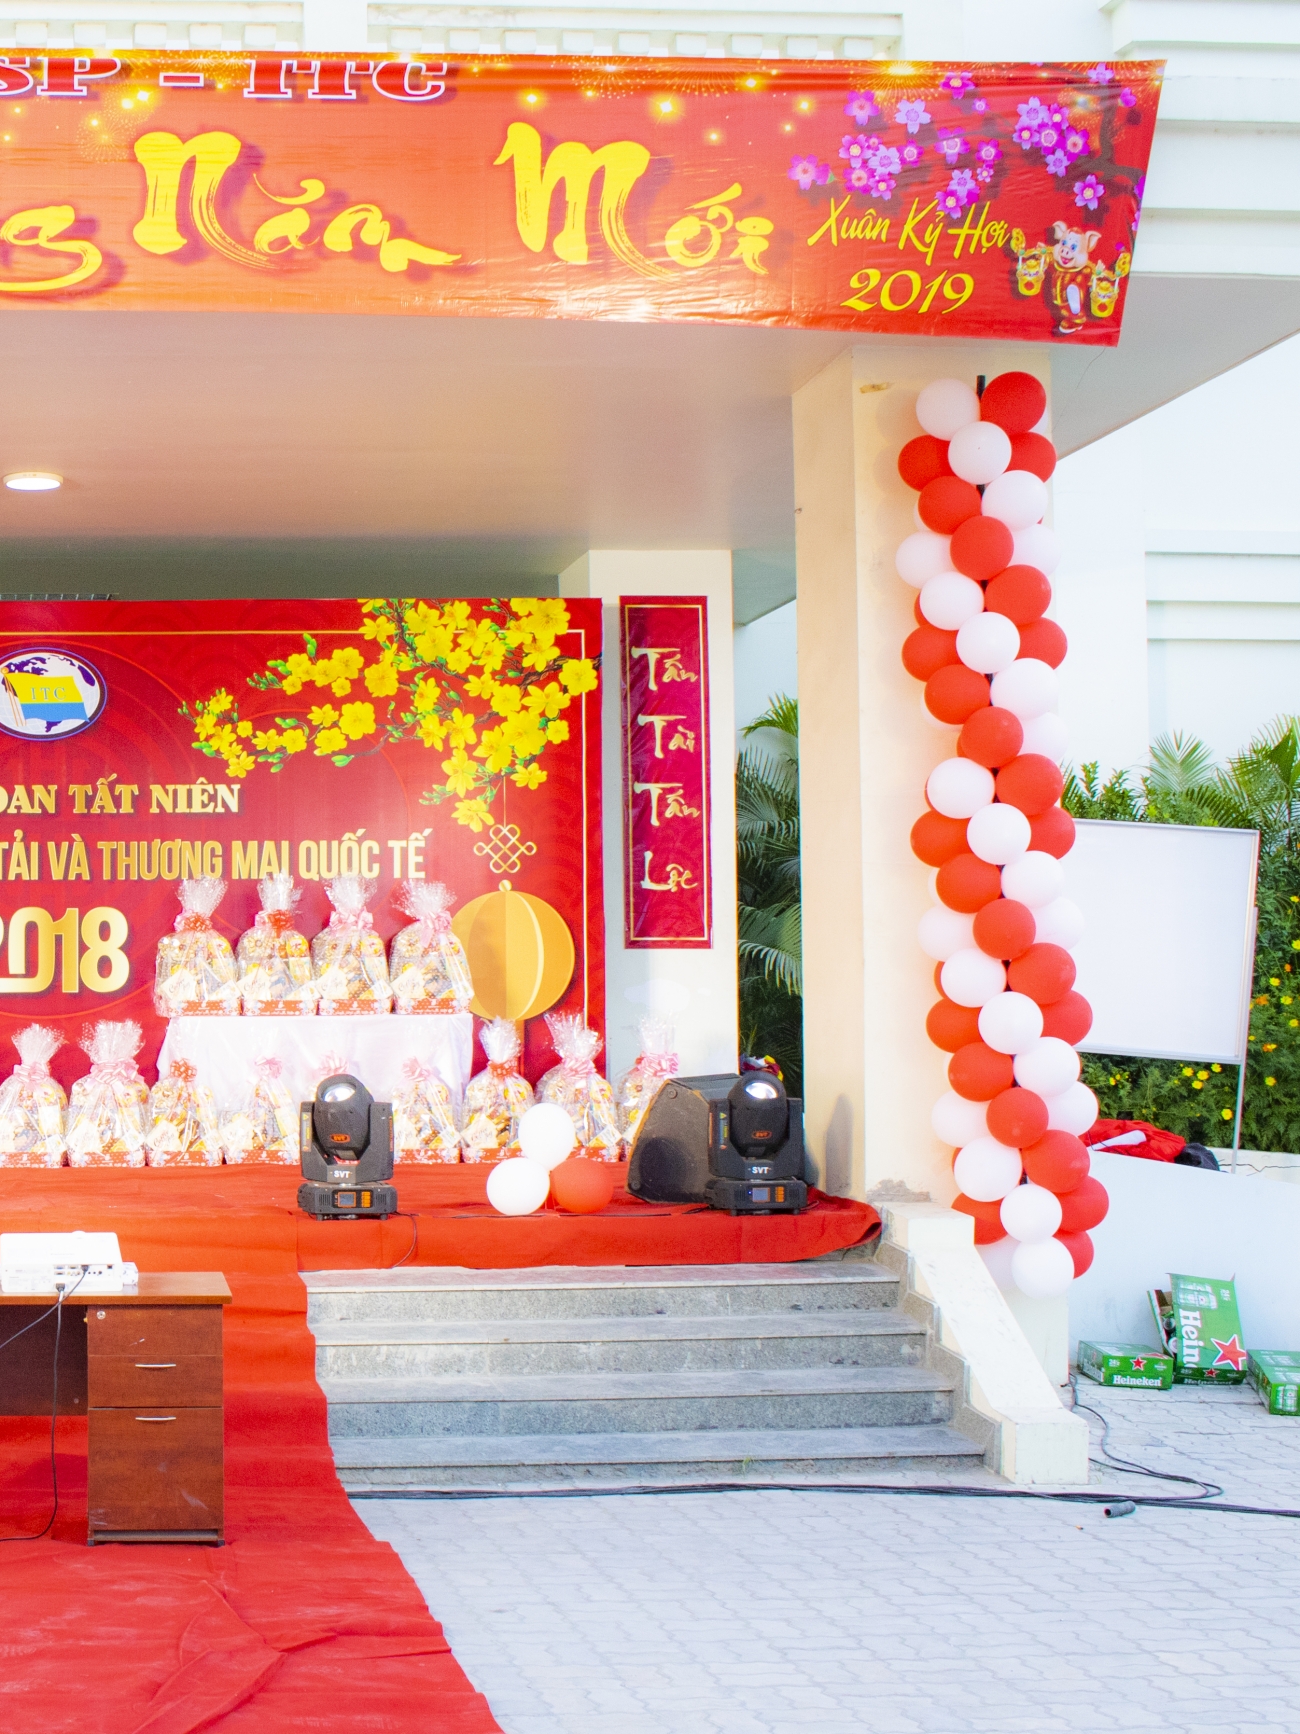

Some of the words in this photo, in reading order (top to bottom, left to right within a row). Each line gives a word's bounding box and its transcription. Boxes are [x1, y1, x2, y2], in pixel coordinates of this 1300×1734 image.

[243, 58, 448, 102] ITC
[492, 121, 775, 286] Mới
[807, 194, 891, 247] Xuân
[898, 196, 945, 267] Kỷ
[840, 267, 975, 315] 2019
[30, 686, 67, 701] ITC
[68, 773, 140, 815] TẤT
[149, 776, 241, 814] NIÊN
[47, 832, 91, 881] VÀ
[97, 837, 223, 881] THƯƠNG
[298, 827, 381, 882] QUỐC
[387, 828, 433, 880] TẾ
[333, 1169, 351, 1179] SVT
[751, 1166, 769, 1175] SVT
[1112, 1374, 1163, 1387] Heineken
